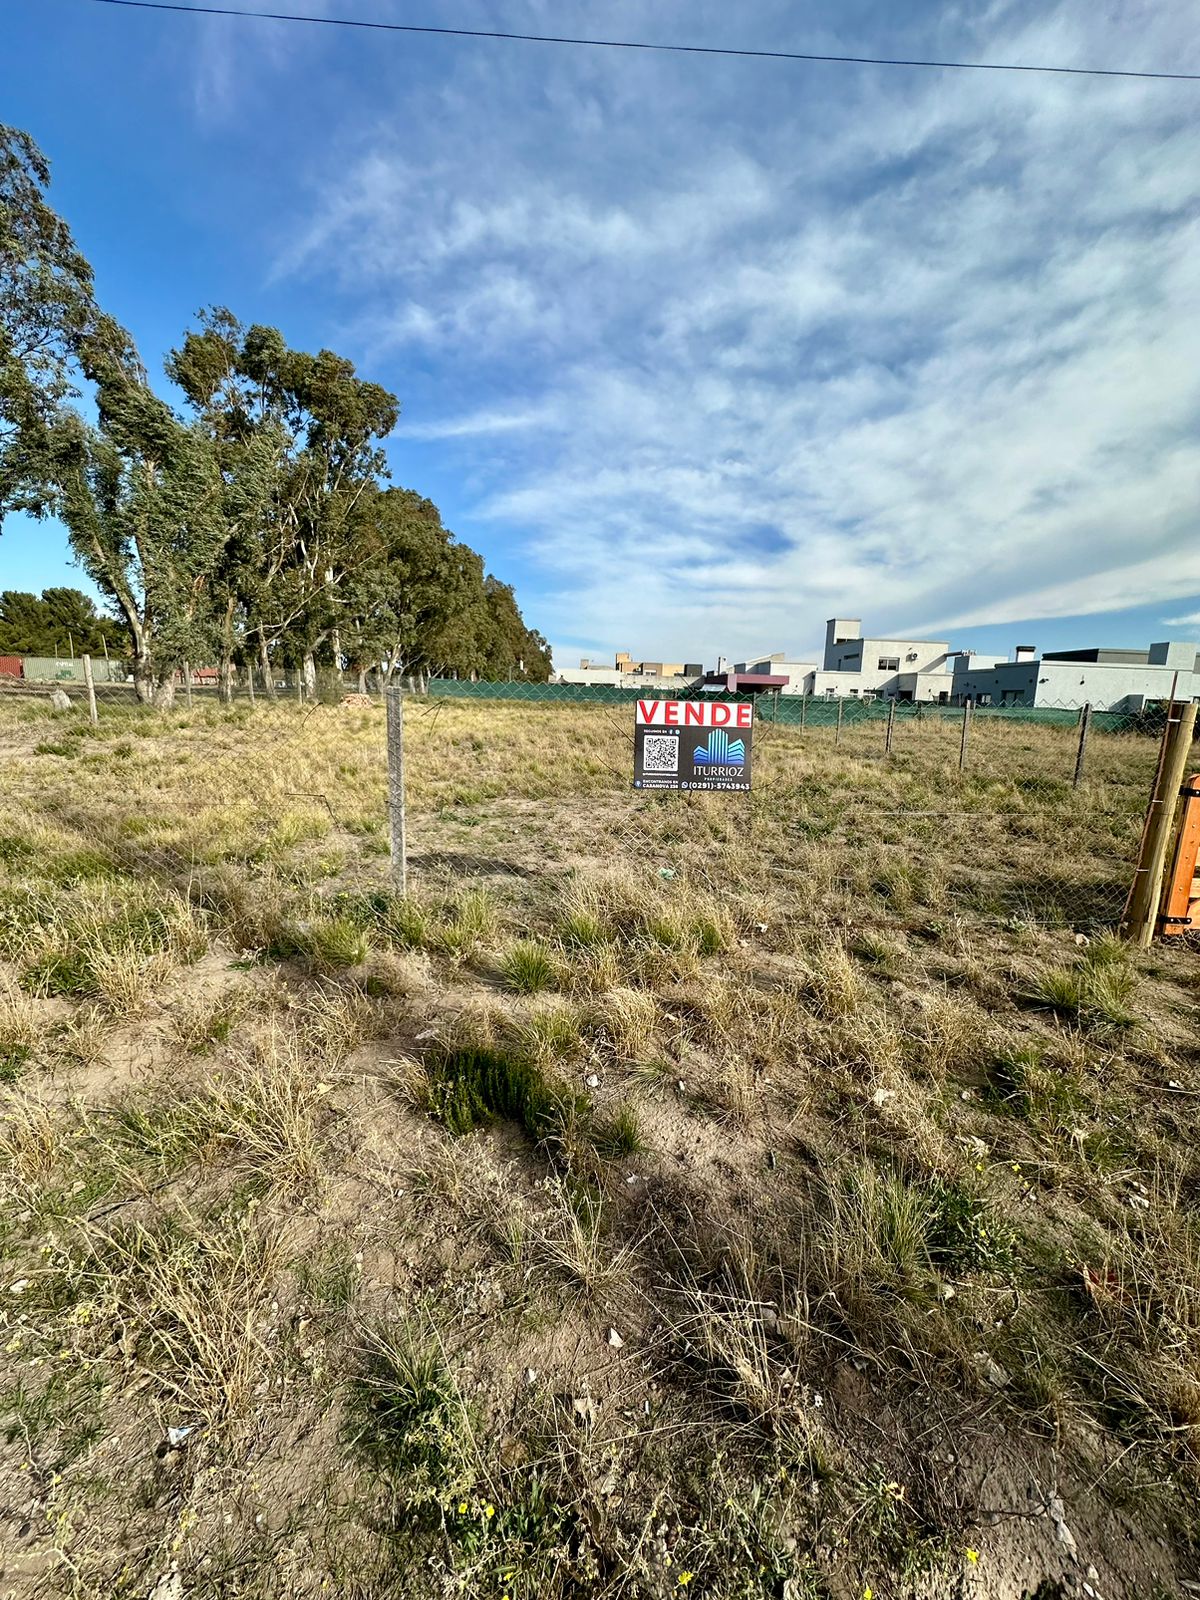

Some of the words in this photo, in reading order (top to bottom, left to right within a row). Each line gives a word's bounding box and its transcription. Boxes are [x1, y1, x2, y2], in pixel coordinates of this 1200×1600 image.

[638, 701, 751, 727] VENDE
[693, 766, 744, 777] ITURRIOZ
[689, 782, 750, 790] (0291)-5743943
